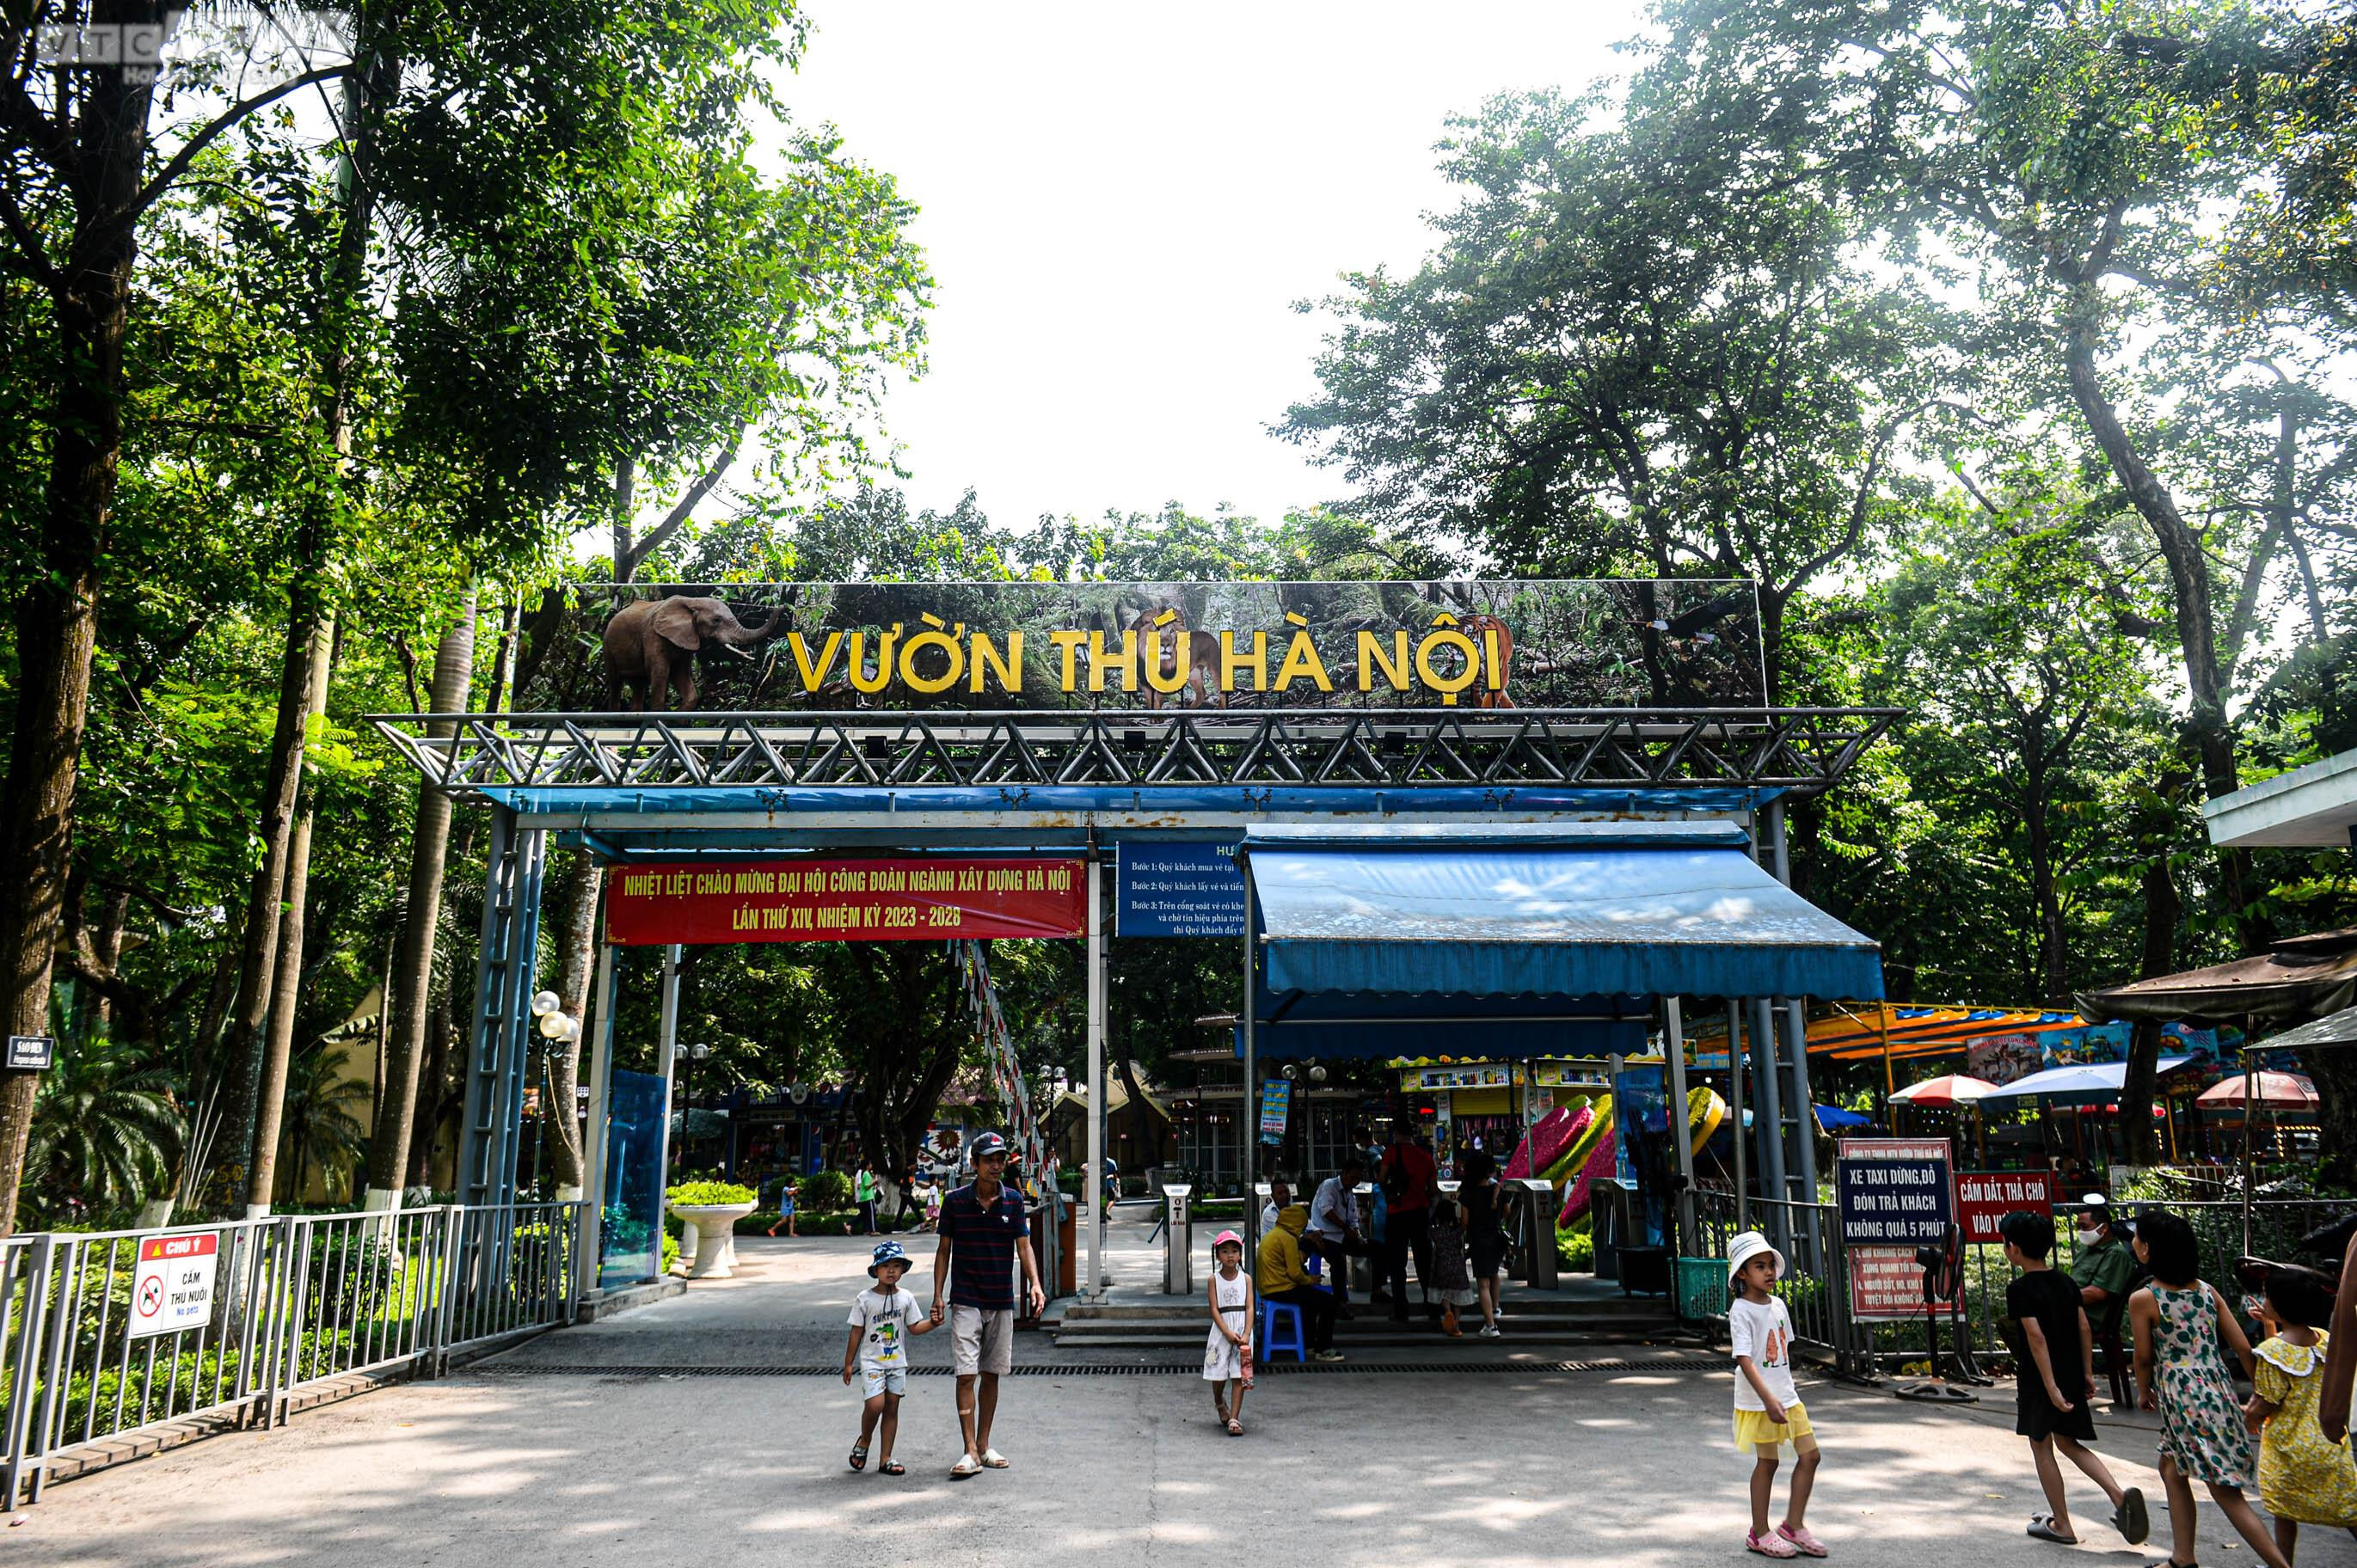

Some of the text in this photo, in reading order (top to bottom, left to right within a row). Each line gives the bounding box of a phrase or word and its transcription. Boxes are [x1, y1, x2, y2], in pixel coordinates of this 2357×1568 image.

[787, 609, 1501, 706] VƯỜN THÚ HÀ NỘI
[1175, 862, 1196, 872] khách
[624, 865, 1071, 900] NHIỆT LIỆT CHÀO MỪNG ĐẠI HỘI CÔNG ĐOÀN NGÀNH XÂY DỰNG HÀ NỘI
[1175, 881, 1196, 891] khách
[1151, 901, 1157, 910] 3:
[733, 902, 758, 930] LẦN
[762, 903, 789, 929] THỨ
[790, 907, 813, 932] XIV,
[817, 903, 860, 933] NHIỆM
[863, 902, 881, 928] KỲ
[884, 906, 917, 927] 2023
[929, 906, 961, 927] 2028
[1201, 925, 1224, 934] khách
[1850, 1169, 1863, 1185] XE
[1865, 1169, 1887, 1185] TAXI
[1961, 1176, 2045, 1204] CẤM DẮT, THẢ CHÓ
[1853, 1190, 1937, 1210] ĐÓN TRẢ KHÁCH
[1846, 1218, 1945, 1239] KHÔNG QUÁ 5 PHÚT
[1972, 1210, 1992, 1234] VÀO
[165, 1237, 201, 1255] CHÚ Ý
[181, 1268, 200, 1285] CẤM
[171, 1287, 207, 1305] THÚ NUÔI
